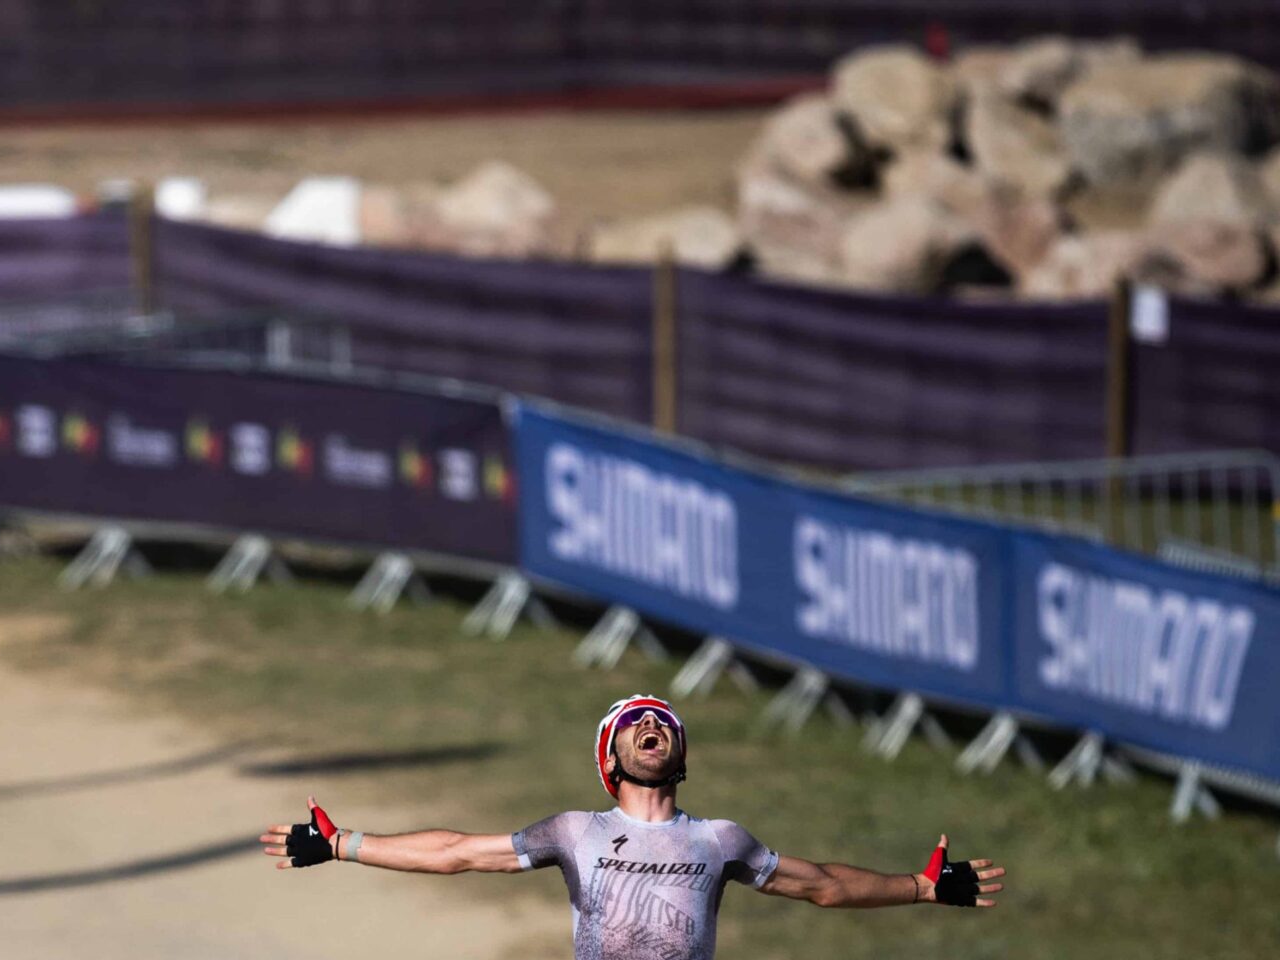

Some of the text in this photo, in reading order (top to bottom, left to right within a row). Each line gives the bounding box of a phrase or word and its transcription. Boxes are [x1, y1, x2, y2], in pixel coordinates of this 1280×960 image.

[545, 444, 738, 611] SHIMANO
[795, 517, 979, 670] SHIMANO
[1038, 562, 1255, 730] SHIMANO
[594, 857, 707, 876] SPECIALIZED
